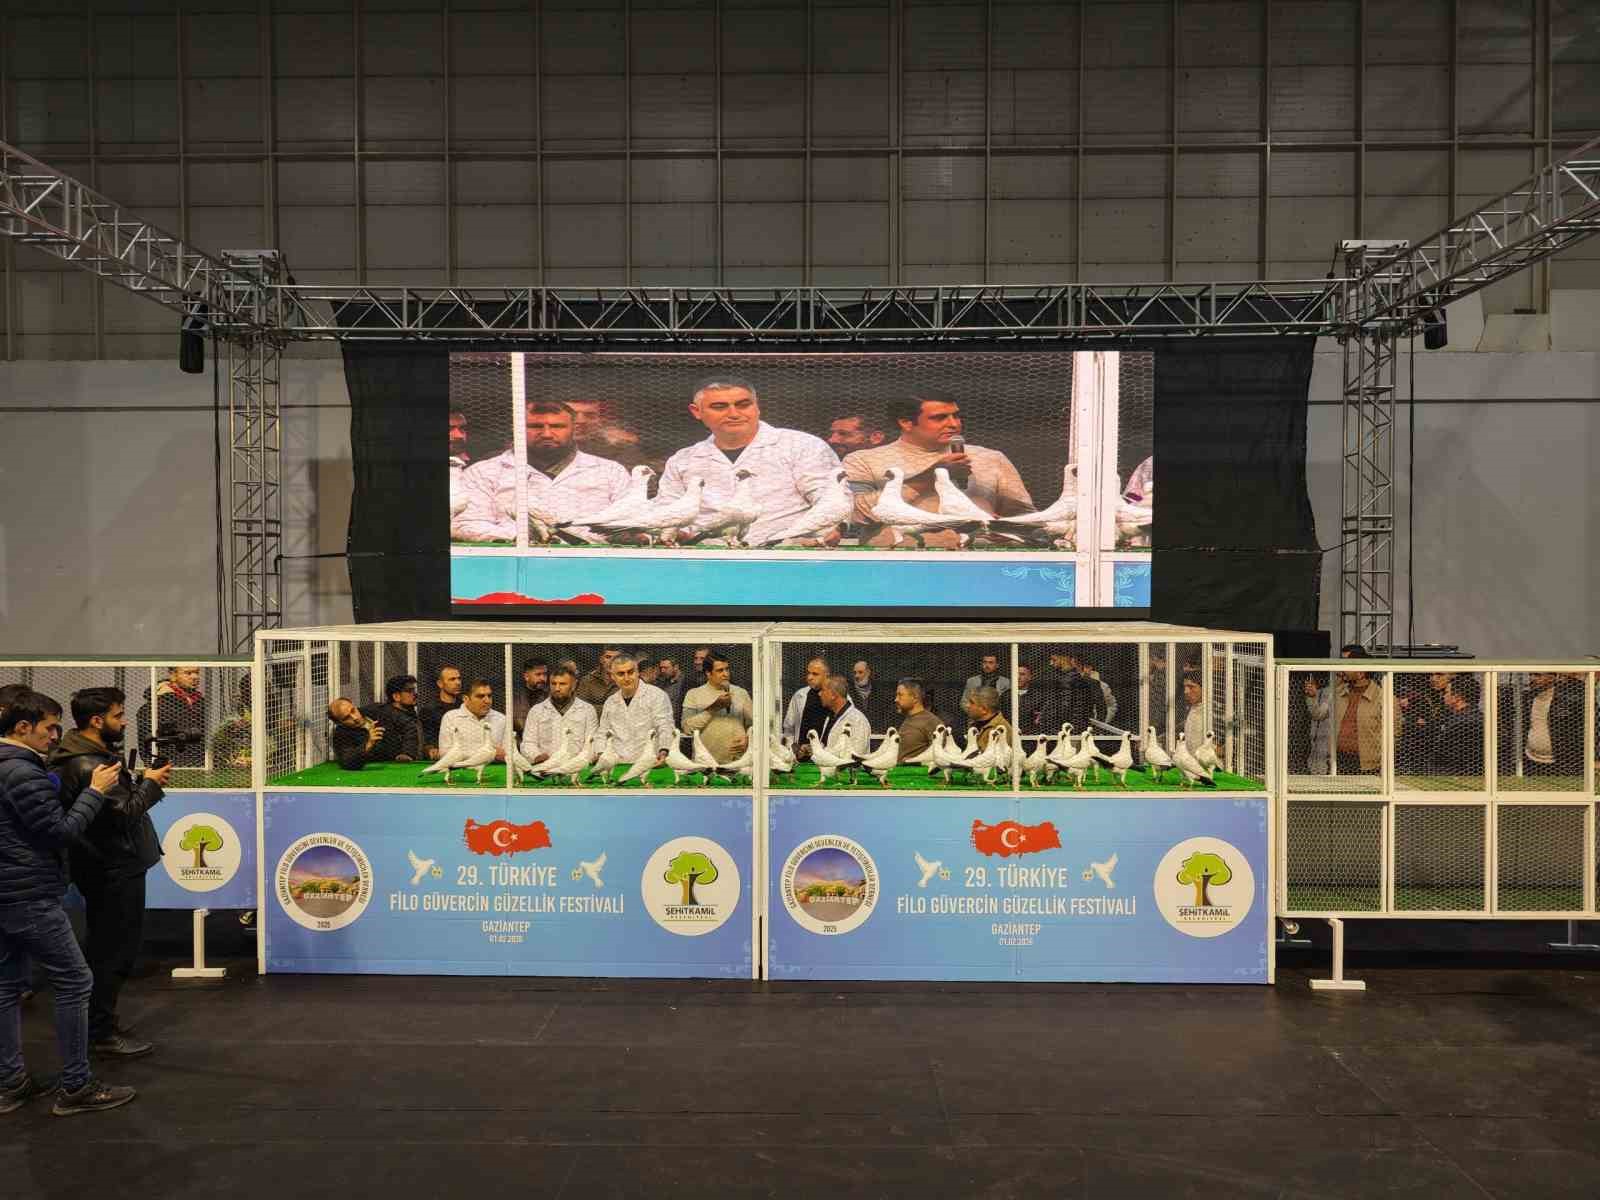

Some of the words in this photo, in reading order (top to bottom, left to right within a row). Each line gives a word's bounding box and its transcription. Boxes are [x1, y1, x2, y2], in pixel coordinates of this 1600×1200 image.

[457, 864, 483, 886] 29.
[488, 862, 557, 887] TÜRKİYE
[964, 866, 992, 888] 29.
[997, 864, 1068, 889] TÜRKİYE
[390, 890, 418, 911] FİLO
[423, 891, 489, 912] GÜVERCİN
[494, 892, 556, 913] GÜZELLİK
[560, 893, 624, 914] FESTİVALİ
[897, 893, 926, 914] FİLO
[931, 894, 998, 914] GÜVERCİN
[1003, 895, 1067, 915] GÜZELLİK
[1071, 895, 1136, 916] FESTİVALİ
[481, 920, 530, 933] GAZİANTEP
[991, 922, 1040, 935] GAZİANTEP
